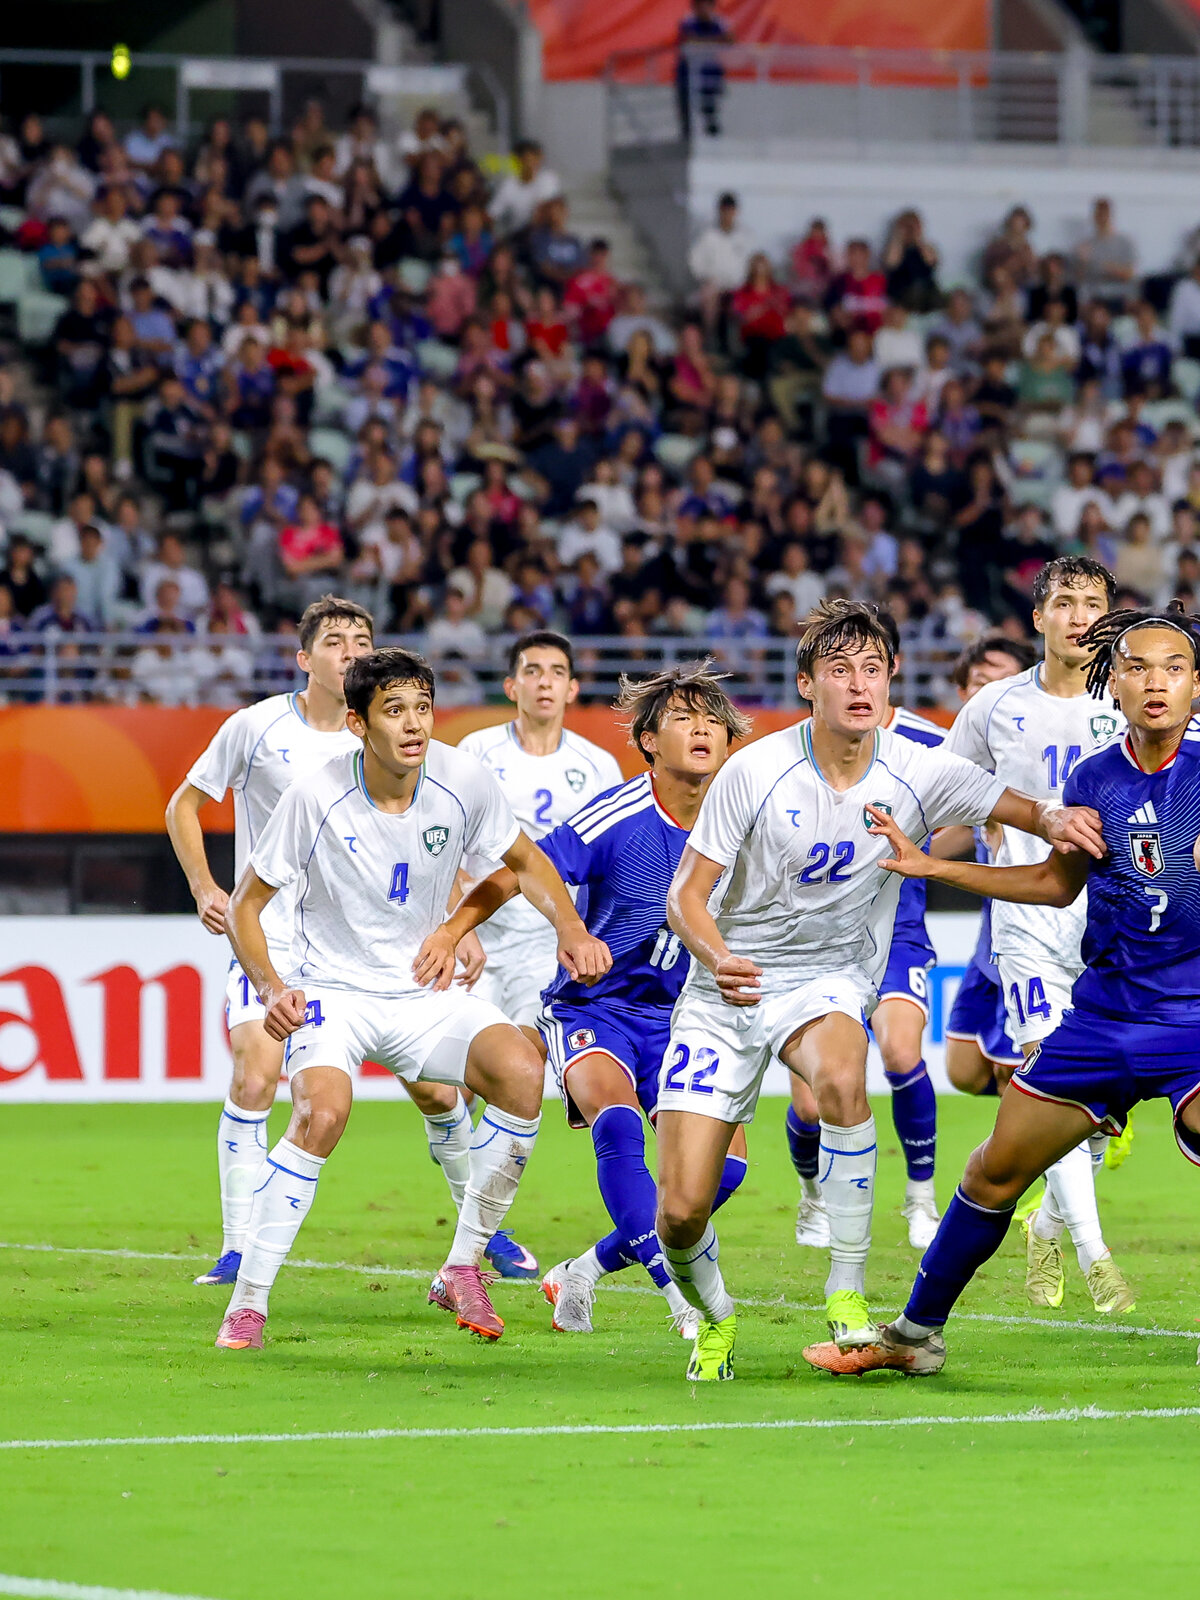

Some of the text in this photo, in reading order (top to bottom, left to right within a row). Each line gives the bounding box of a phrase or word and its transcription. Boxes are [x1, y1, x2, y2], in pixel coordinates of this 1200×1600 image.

[1092, 719, 1114, 733] UFA
[1042, 745, 1082, 790] 14
[535, 788, 553, 824] 2
[426, 829, 447, 844] UFA
[797, 840, 855, 884] 22
[387, 862, 410, 906] 4
[1144, 885, 1169, 932] 7
[237, 973, 264, 1009] 1
[908, 966, 927, 999] 6
[304, 999, 326, 1029] 4
[1010, 976, 1052, 1027] 14
[663, 1043, 720, 1097] 22
[629, 1229, 657, 1247] JAPA
